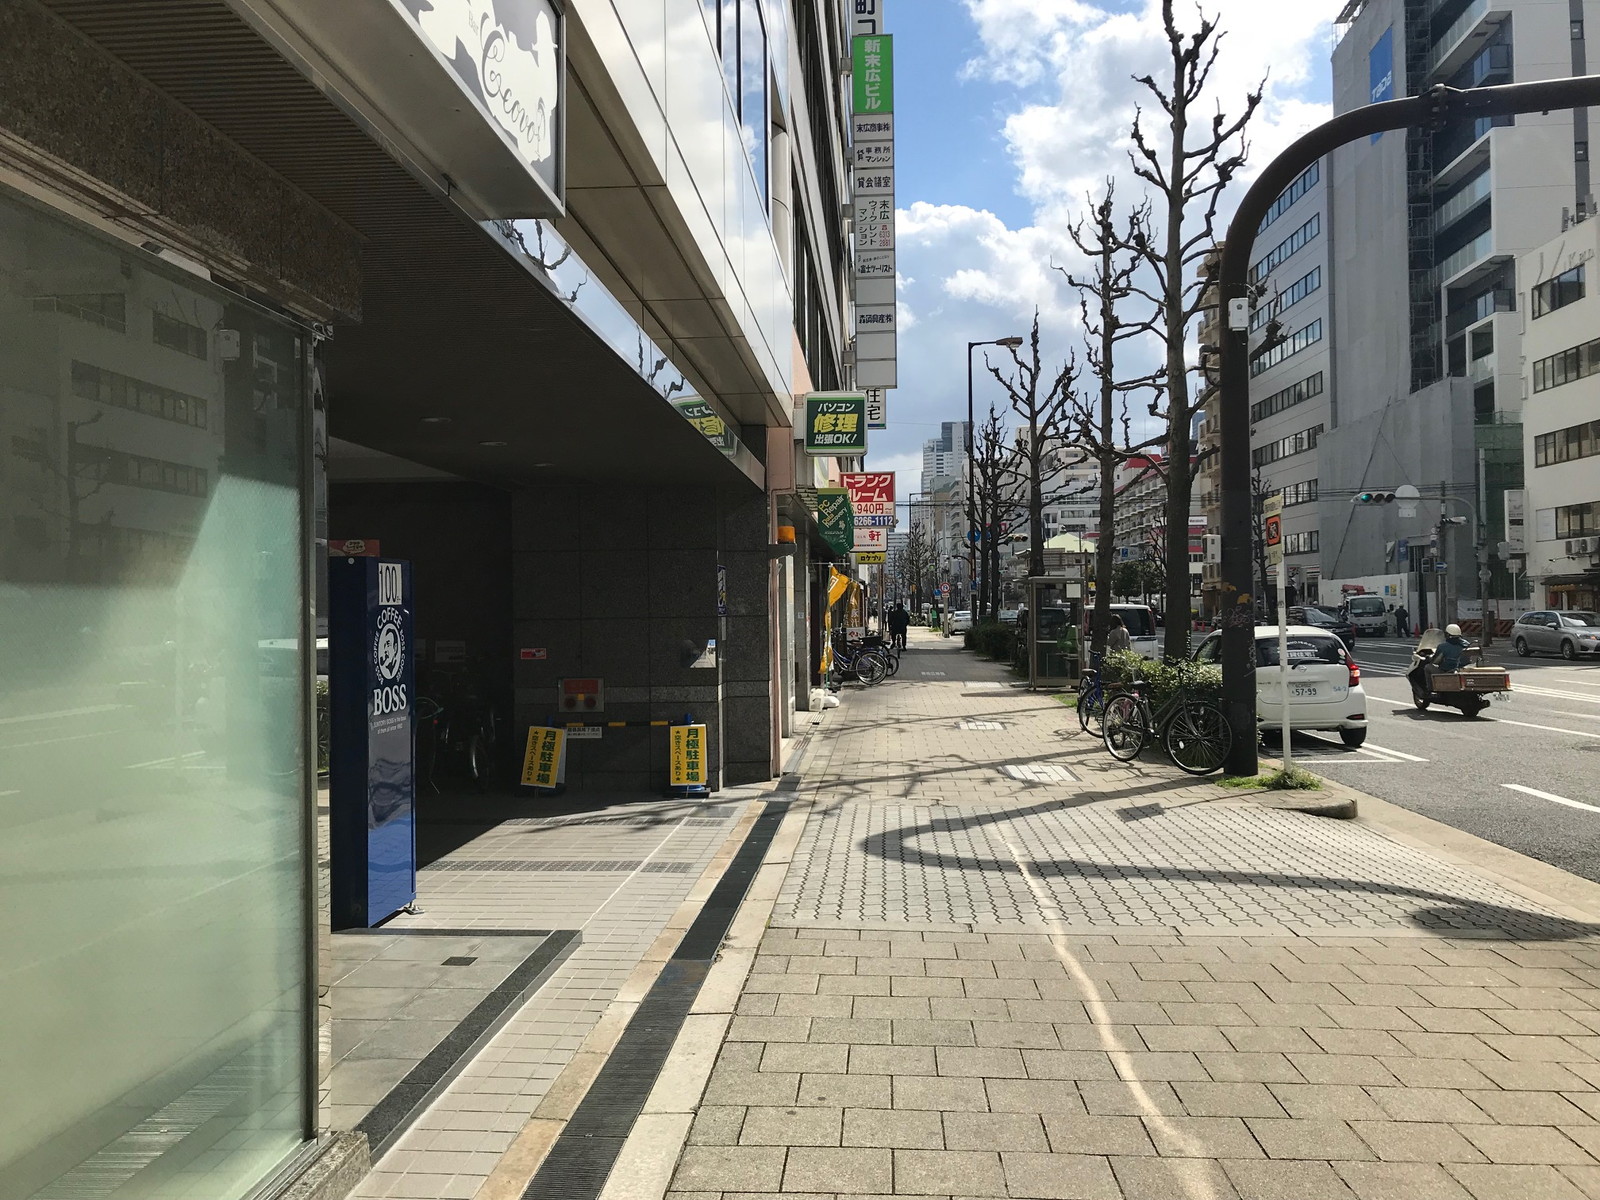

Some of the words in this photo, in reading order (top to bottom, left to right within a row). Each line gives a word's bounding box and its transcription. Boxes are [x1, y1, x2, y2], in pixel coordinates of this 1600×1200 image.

[864, 39, 881, 110] 新末広ビル
[865, 155, 891, 163] マンション
[866, 146, 891, 154] 事務所
[857, 176, 891, 188] 貸会議室
[879, 200, 890, 220] 末広
[859, 208, 868, 246] マンション
[818, 402, 855, 412] パソコン
[813, 412, 859, 433] 修理
[814, 433, 858, 445] 出張OK!
[843, 474, 891, 488] トランク
[823, 494, 846, 516] Repair
[849, 488, 888, 502] ルーム
[853, 516, 893, 526] 6266-1112
[868, 530, 881, 541] 軒
[378, 565, 398, 603] 100
[376, 606, 403, 629] COFFEE
[373, 683, 407, 716] BOSS
[1295, 688, 1317, 696] 57-99
[536, 730, 557, 784] 月極駐車場
[674, 734, 682, 777] 空きスペースあり
[686, 728, 700, 782] 月極駐車場
